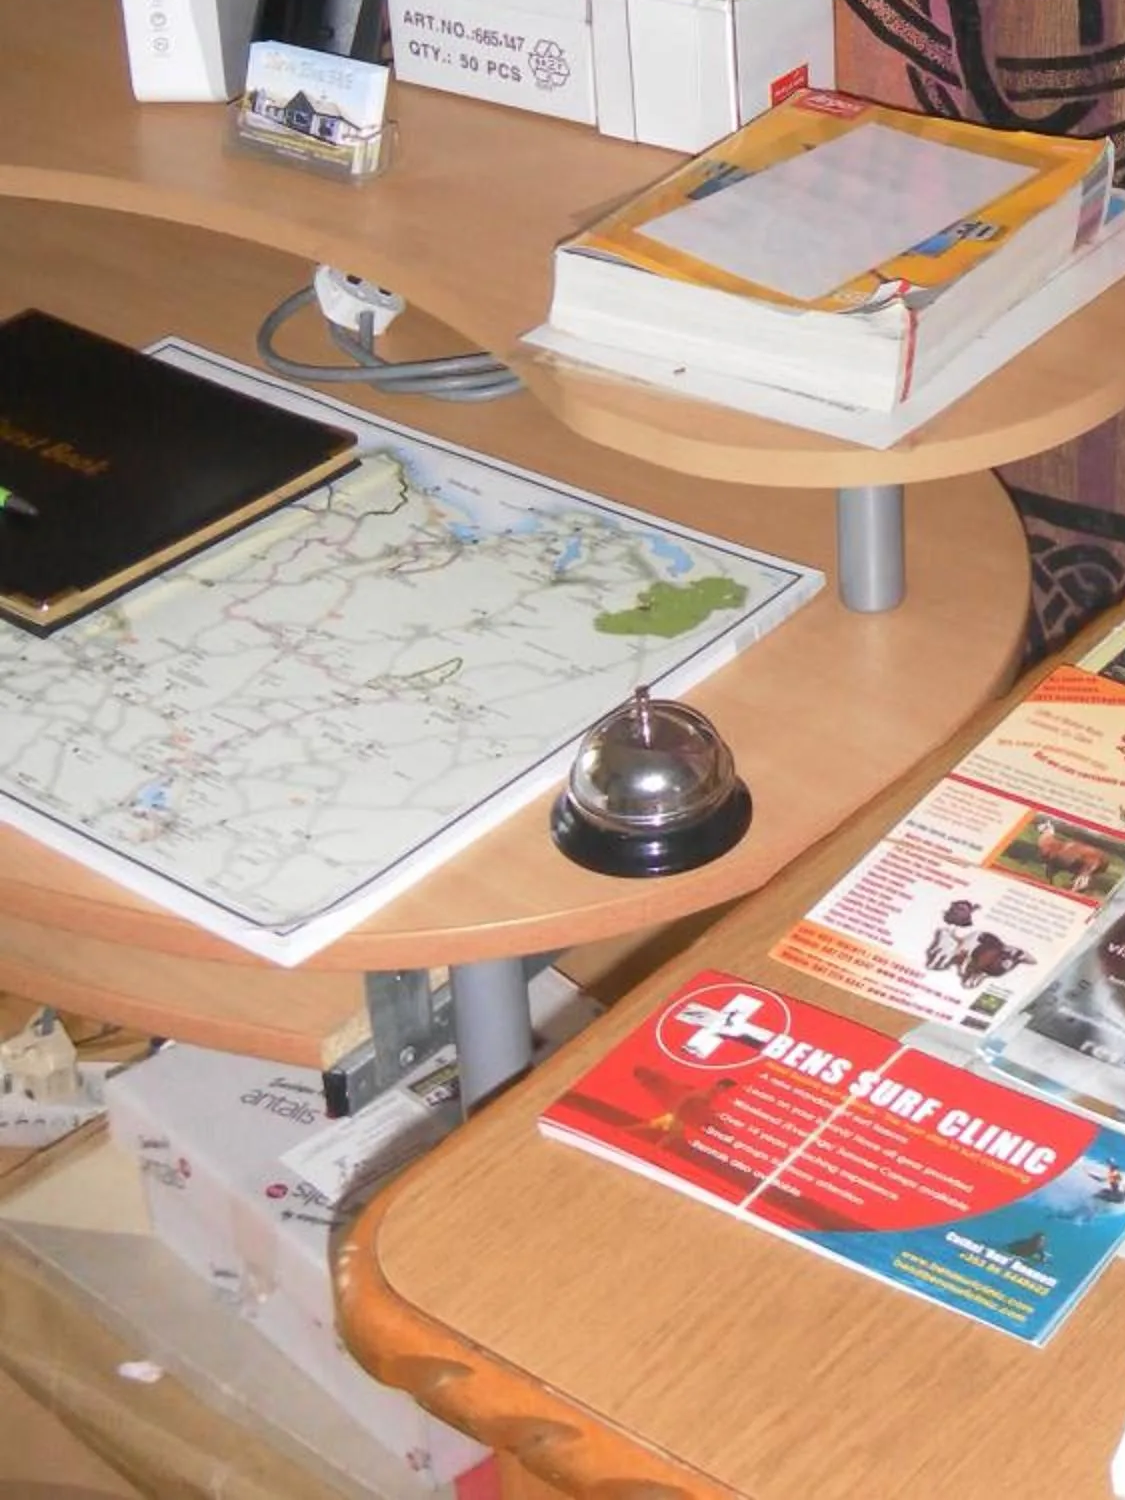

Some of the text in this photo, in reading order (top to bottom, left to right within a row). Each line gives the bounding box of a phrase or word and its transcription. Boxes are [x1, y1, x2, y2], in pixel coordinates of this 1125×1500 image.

[459, 53, 479, 73] 50
[487, 59, 522, 83] PCS
[240, 1084, 324, 1125] antalis
[762, 1033, 851, 1084] BENS
[849, 1070, 943, 1123] SURF
[936, 1108, 1057, 1175] CLINIC
